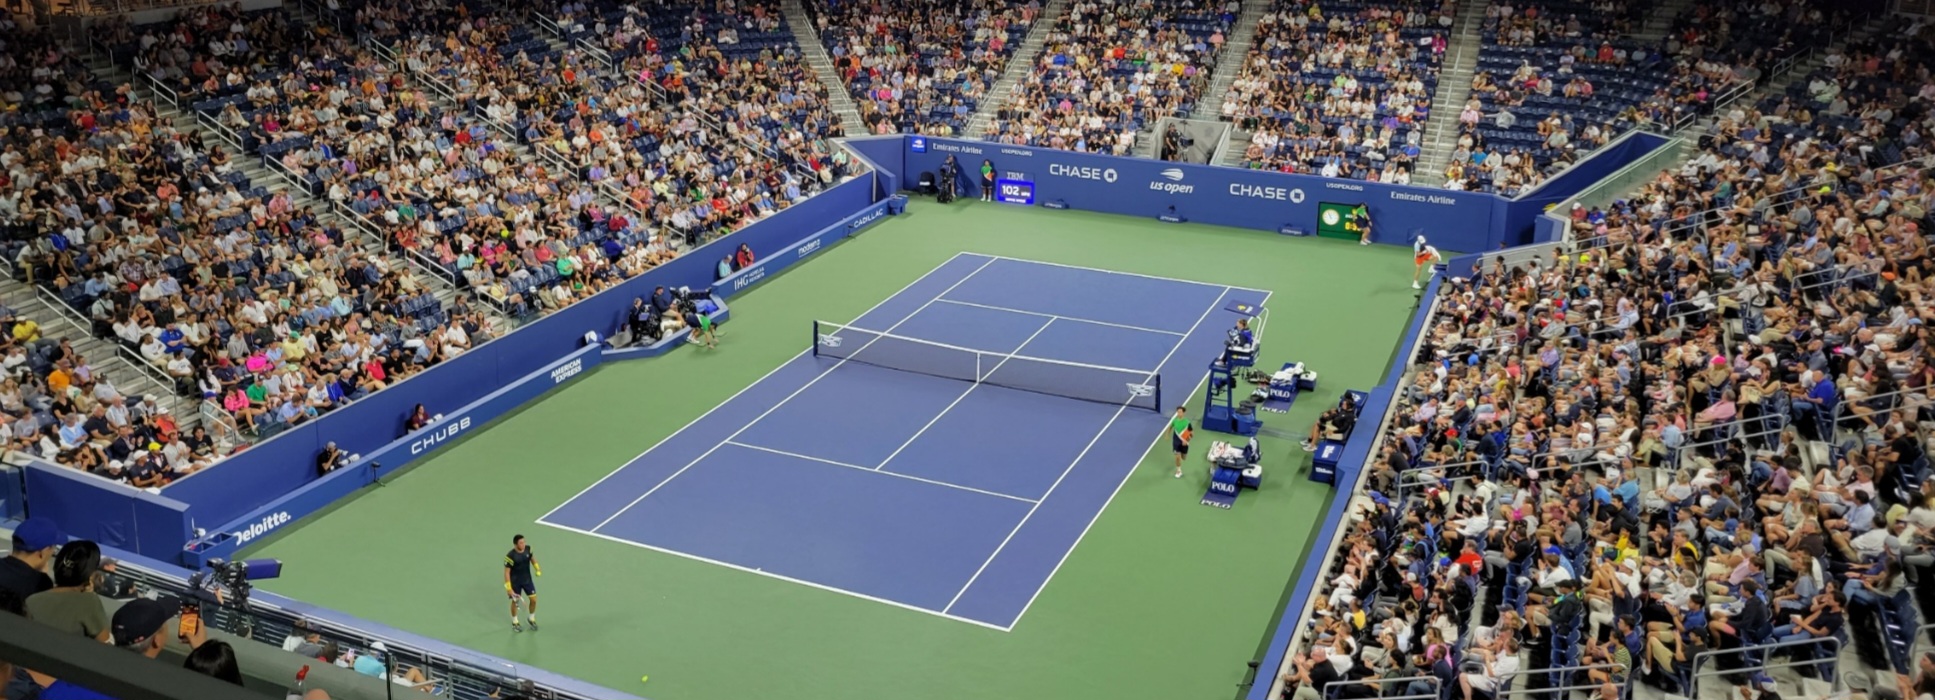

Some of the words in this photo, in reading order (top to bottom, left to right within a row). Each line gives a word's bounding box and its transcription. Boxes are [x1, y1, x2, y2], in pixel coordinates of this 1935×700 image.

[932, 142, 960, 152] Emirates
[961, 145, 983, 155] Airline
[1006, 171, 1025, 182] IBM
[1049, 163, 1102, 181] CHASE
[1002, 185, 1020, 196] 102
[1149, 181, 1164, 191] us
[1164, 183, 1194, 195] open
[1229, 183, 1287, 201] CHASE
[1325, 182, 1364, 192] USOPEN.ORG
[1391, 191, 1426, 203] Emirates
[1427, 195, 1456, 206] Airline
[853, 208, 884, 229] CADILLAC
[734, 274, 749, 292] IHG
[550, 357, 581, 379] AMERICAN
[555, 366, 582, 384] EXPRESS
[1269, 388, 1290, 398] POLO
[1261, 406, 1287, 414] POLO
[411, 416, 471, 456] CHUBB
[1211, 481, 1235, 493] POLO
[1200, 499, 1231, 509] POLO
